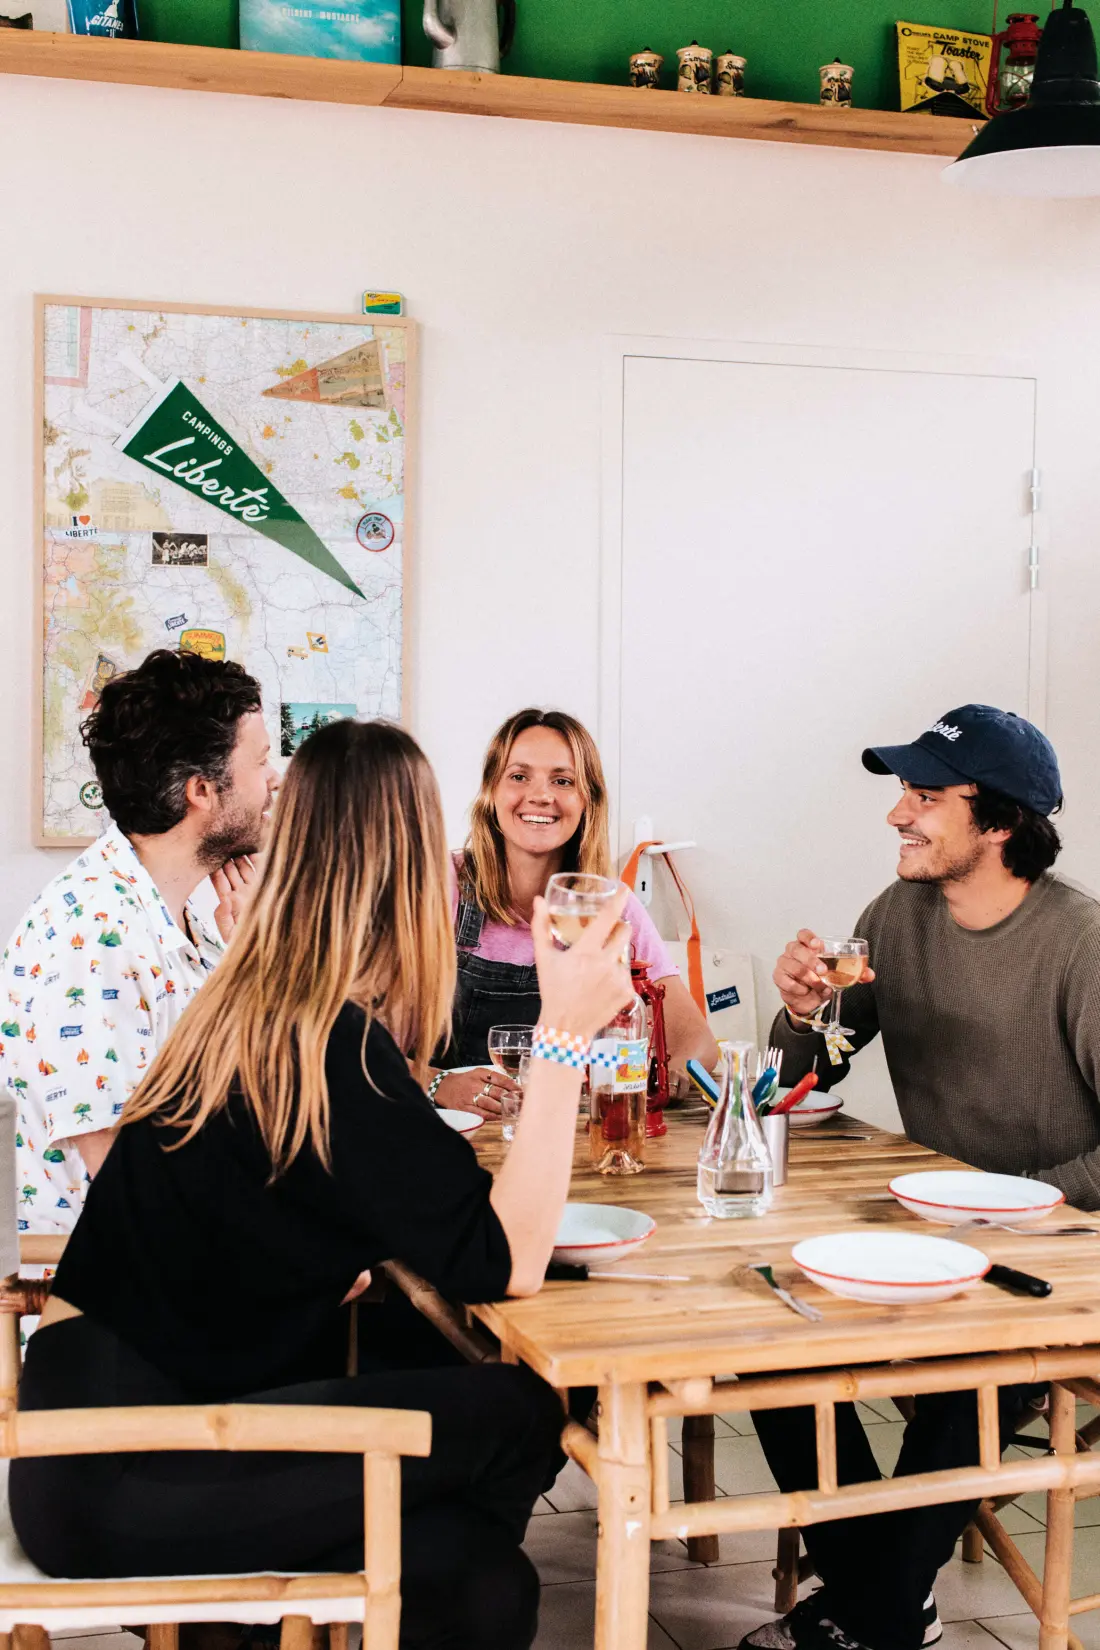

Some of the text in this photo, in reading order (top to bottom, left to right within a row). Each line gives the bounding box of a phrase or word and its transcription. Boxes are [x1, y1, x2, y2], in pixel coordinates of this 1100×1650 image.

[933, 32, 960, 42] CAMP
[962, 37, 990, 48] STOVE
[935, 40, 984, 60] Toaster
[182, 410, 234, 456] CAMPINGS
[142, 436, 270, 522] Liberté
